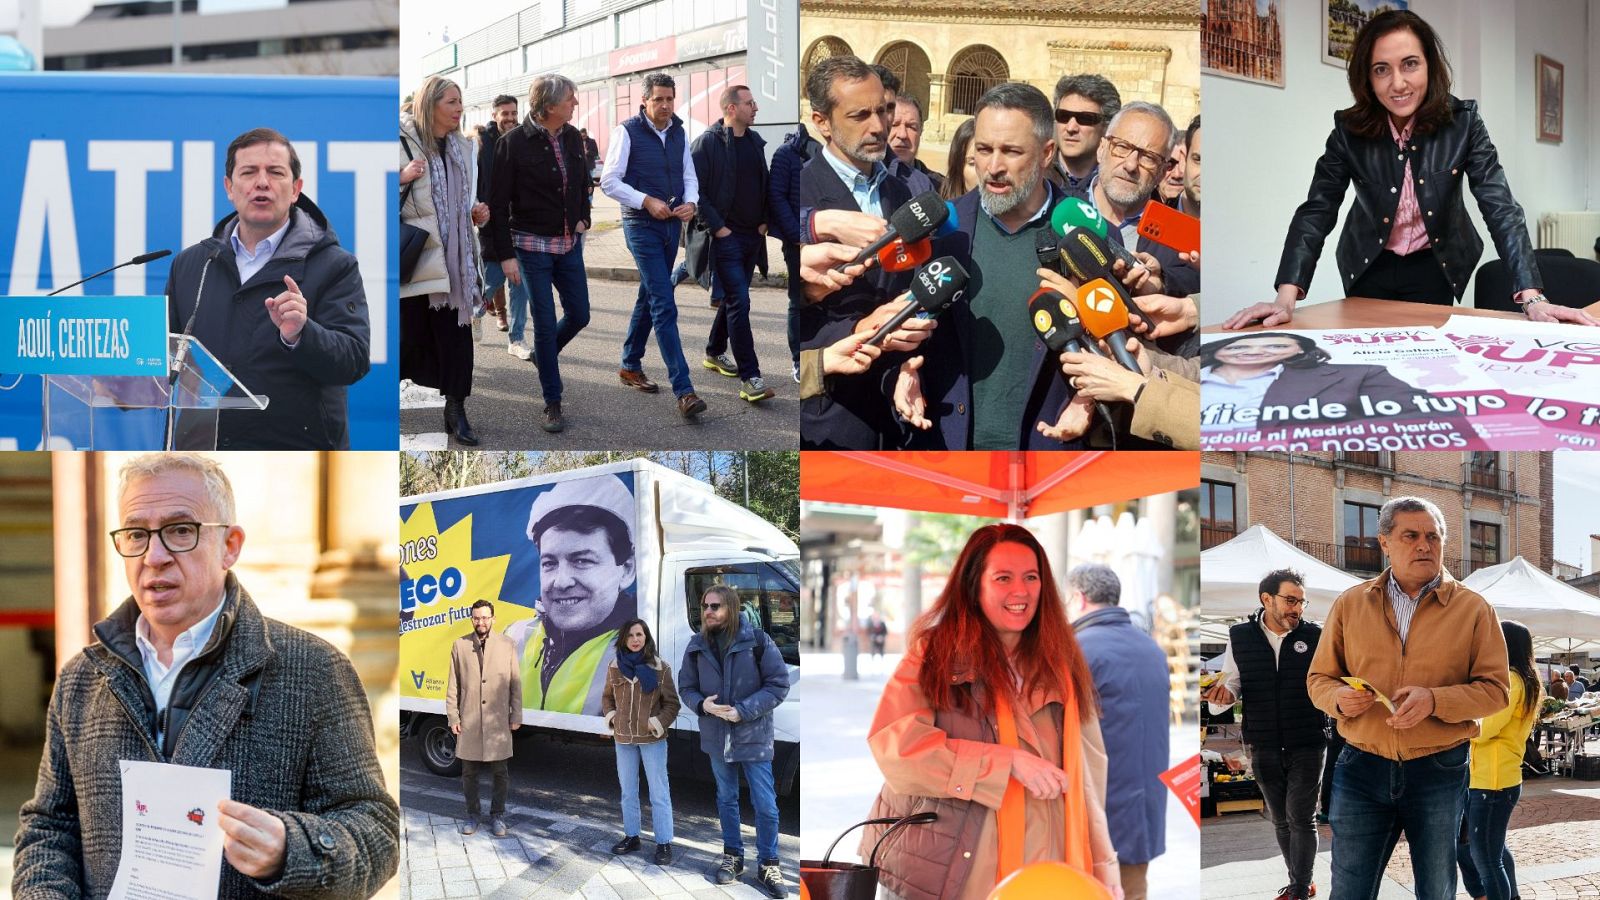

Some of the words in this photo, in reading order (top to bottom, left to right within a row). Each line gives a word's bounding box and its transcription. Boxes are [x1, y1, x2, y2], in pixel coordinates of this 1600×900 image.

[17, 309, 55, 361] AQUÍ,
[58, 318, 129, 360] CERTEZAS
[1352, 335, 1436, 344] UPL
[1360, 395, 1402, 417] lo
[1412, 394, 1507, 416] tuyo
[1526, 397, 1567, 421] lo
[1268, 428, 1287, 441] ni
[1293, 424, 1365, 439] Madrid
[1370, 424, 1389, 434] lo
[1393, 420, 1453, 434] harán
[1555, 432, 1596, 447] rán
[1322, 432, 1468, 451] nosotros
